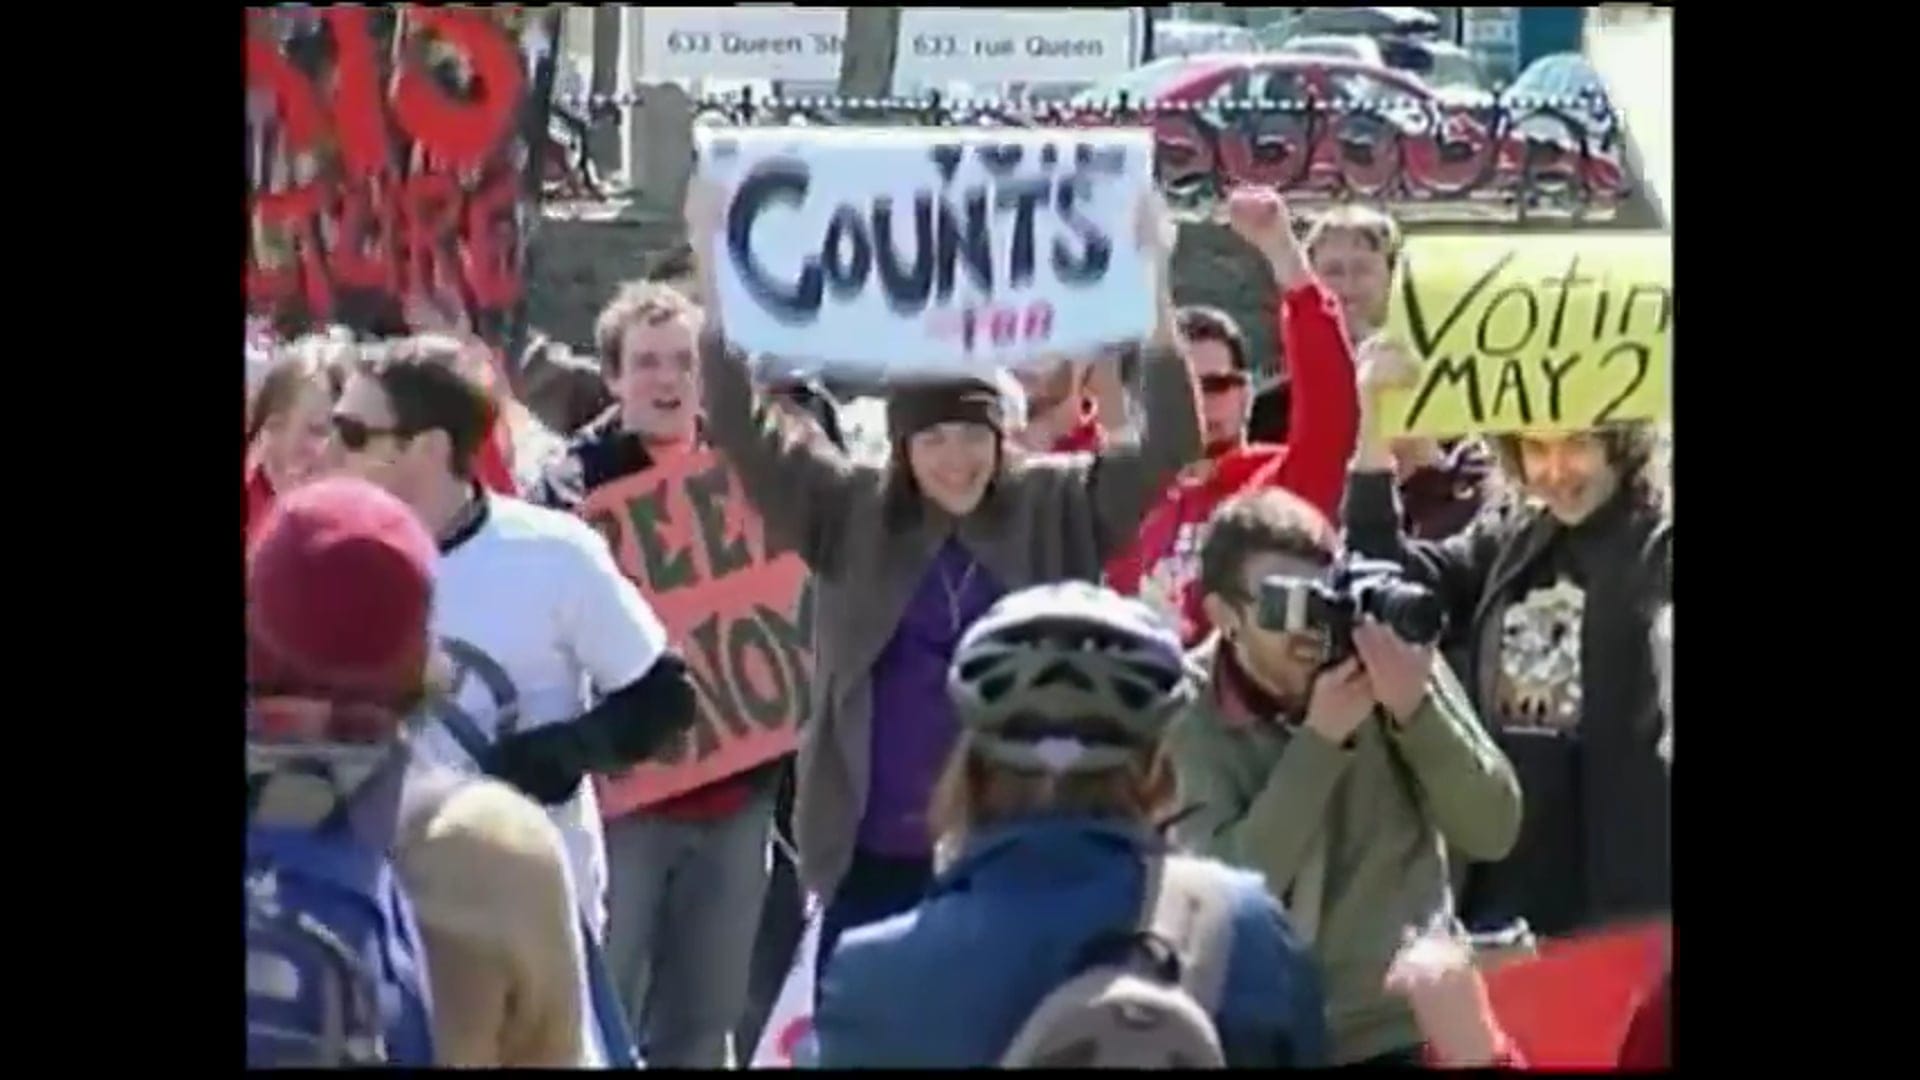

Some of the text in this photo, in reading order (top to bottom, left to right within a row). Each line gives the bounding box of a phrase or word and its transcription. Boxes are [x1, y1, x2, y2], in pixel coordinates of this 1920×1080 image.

[720, 33, 803, 54] Queen
[1025, 36, 1104, 58] Queen
[727, 155, 1112, 325] COUNTS
[1405, 341, 1654, 430] MAY 2
